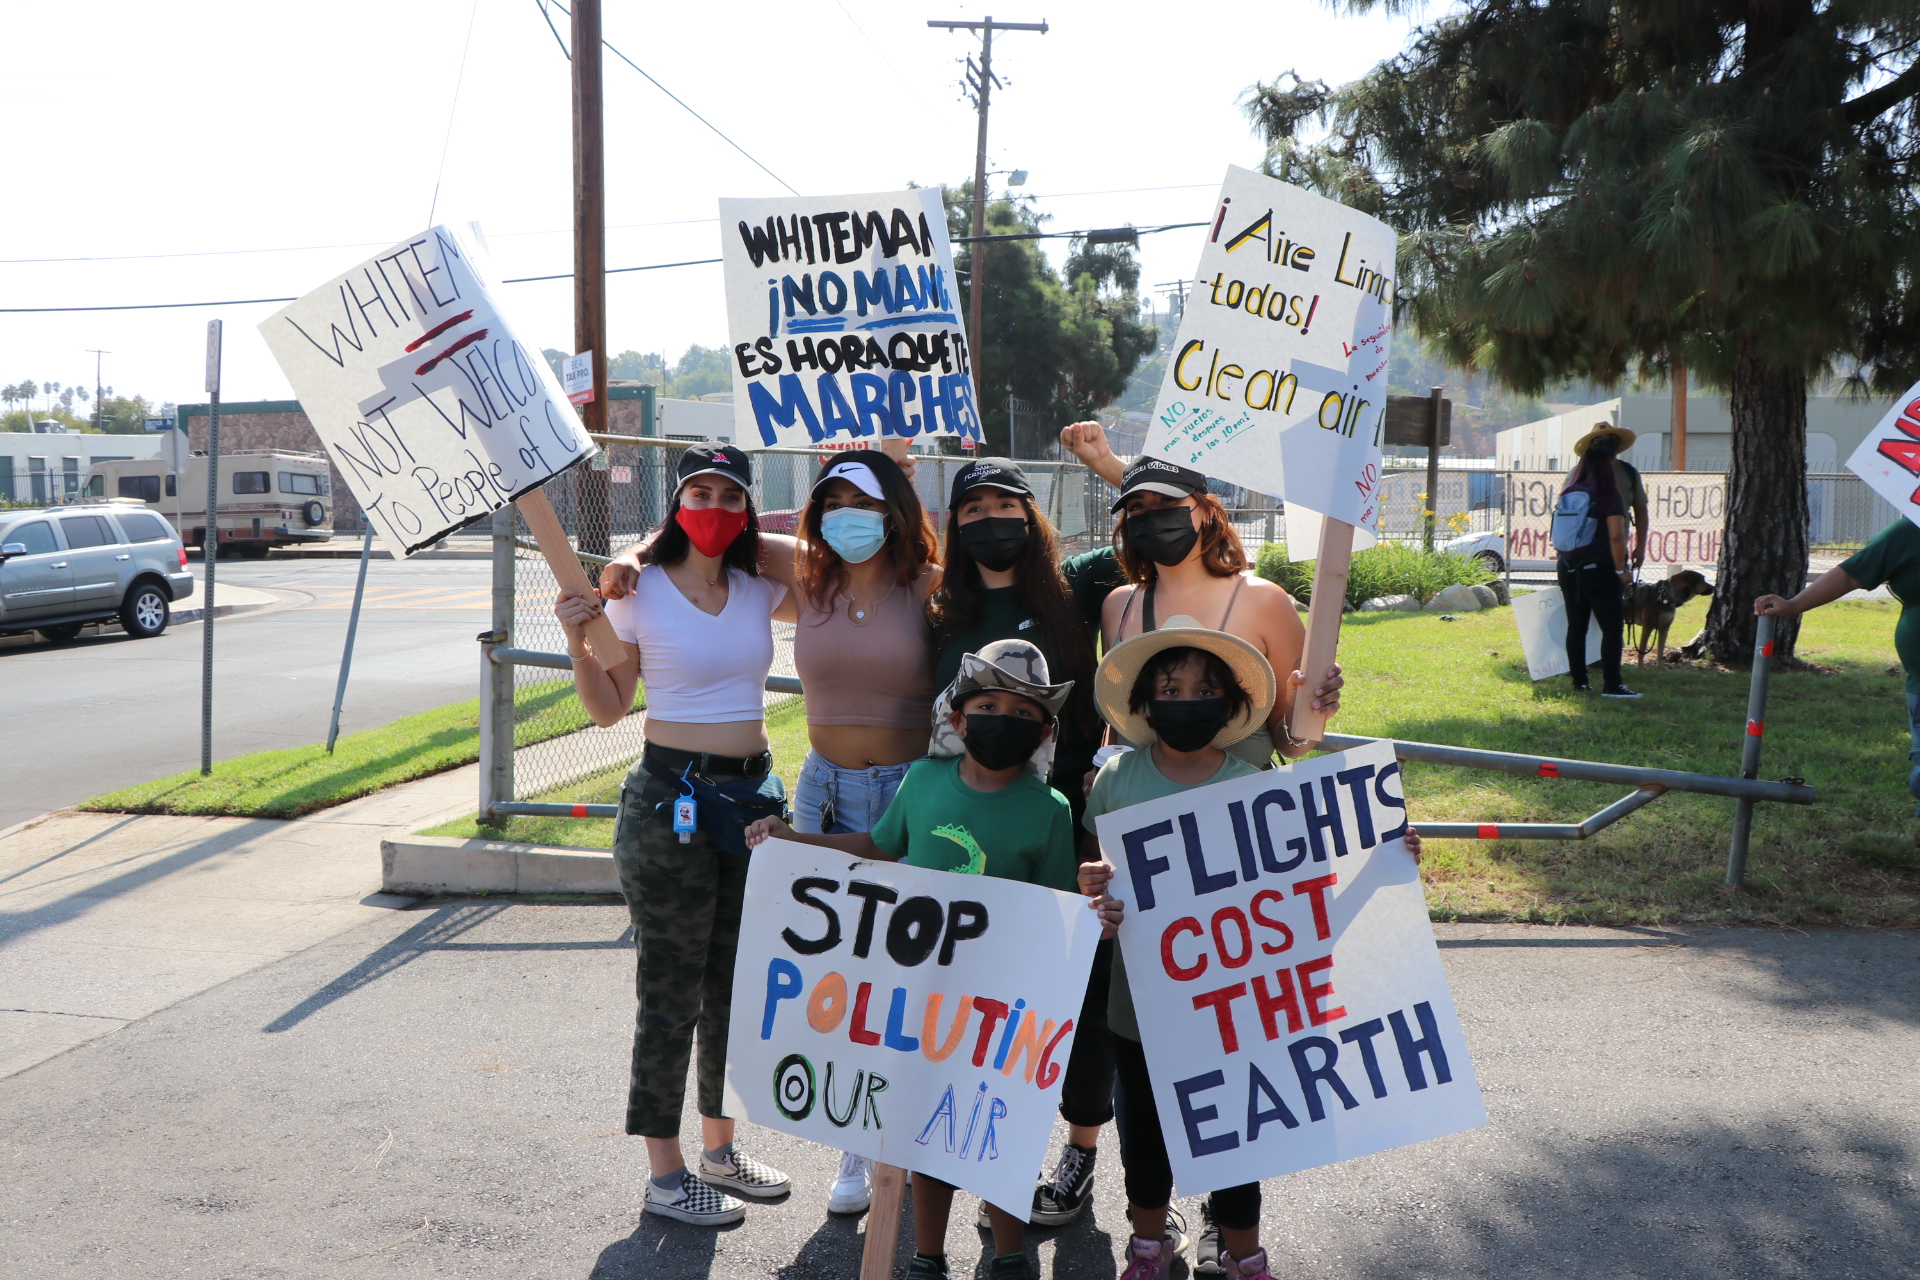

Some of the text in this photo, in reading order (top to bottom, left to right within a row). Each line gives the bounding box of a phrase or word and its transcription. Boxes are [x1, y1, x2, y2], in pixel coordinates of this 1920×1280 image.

[735, 336, 782, 378] ES
[786, 335, 890, 374] HORA
[887, 329, 952, 374] QUE
[1342, 341, 1358, 357] La
[566, 371, 577, 382] TAX
[1173, 339, 1298, 417] Clean
[1318, 384, 1370, 439] air
[747, 370, 980, 447] MARCHES
[1160, 401, 1187, 428] NO
[1192, 416, 1226, 443] despues
[334, 396, 415, 491] NOT
[974, 464, 989, 472] SAN
[1147, 461, 1179, 474] Vibras
[1163, 436, 1180, 452] mas
[1190, 451, 1204, 463] de
[1206, 438, 1220, 450] las
[366, 492, 421, 550] TO
[411, 449, 517, 523] People
[519, 415, 552, 475] of
[964, 468, 1001, 482] FERNANDO
[1355, 463, 1377, 498] NO
[1122, 762, 1407, 912] FLIGHTS
[781, 875, 989, 967] STOP
[1160, 873, 1337, 981] COST
[1192, 955, 1347, 1055] THE
[772, 1053, 889, 1130] OUR
[1173, 1001, 1452, 1158] EARTH
